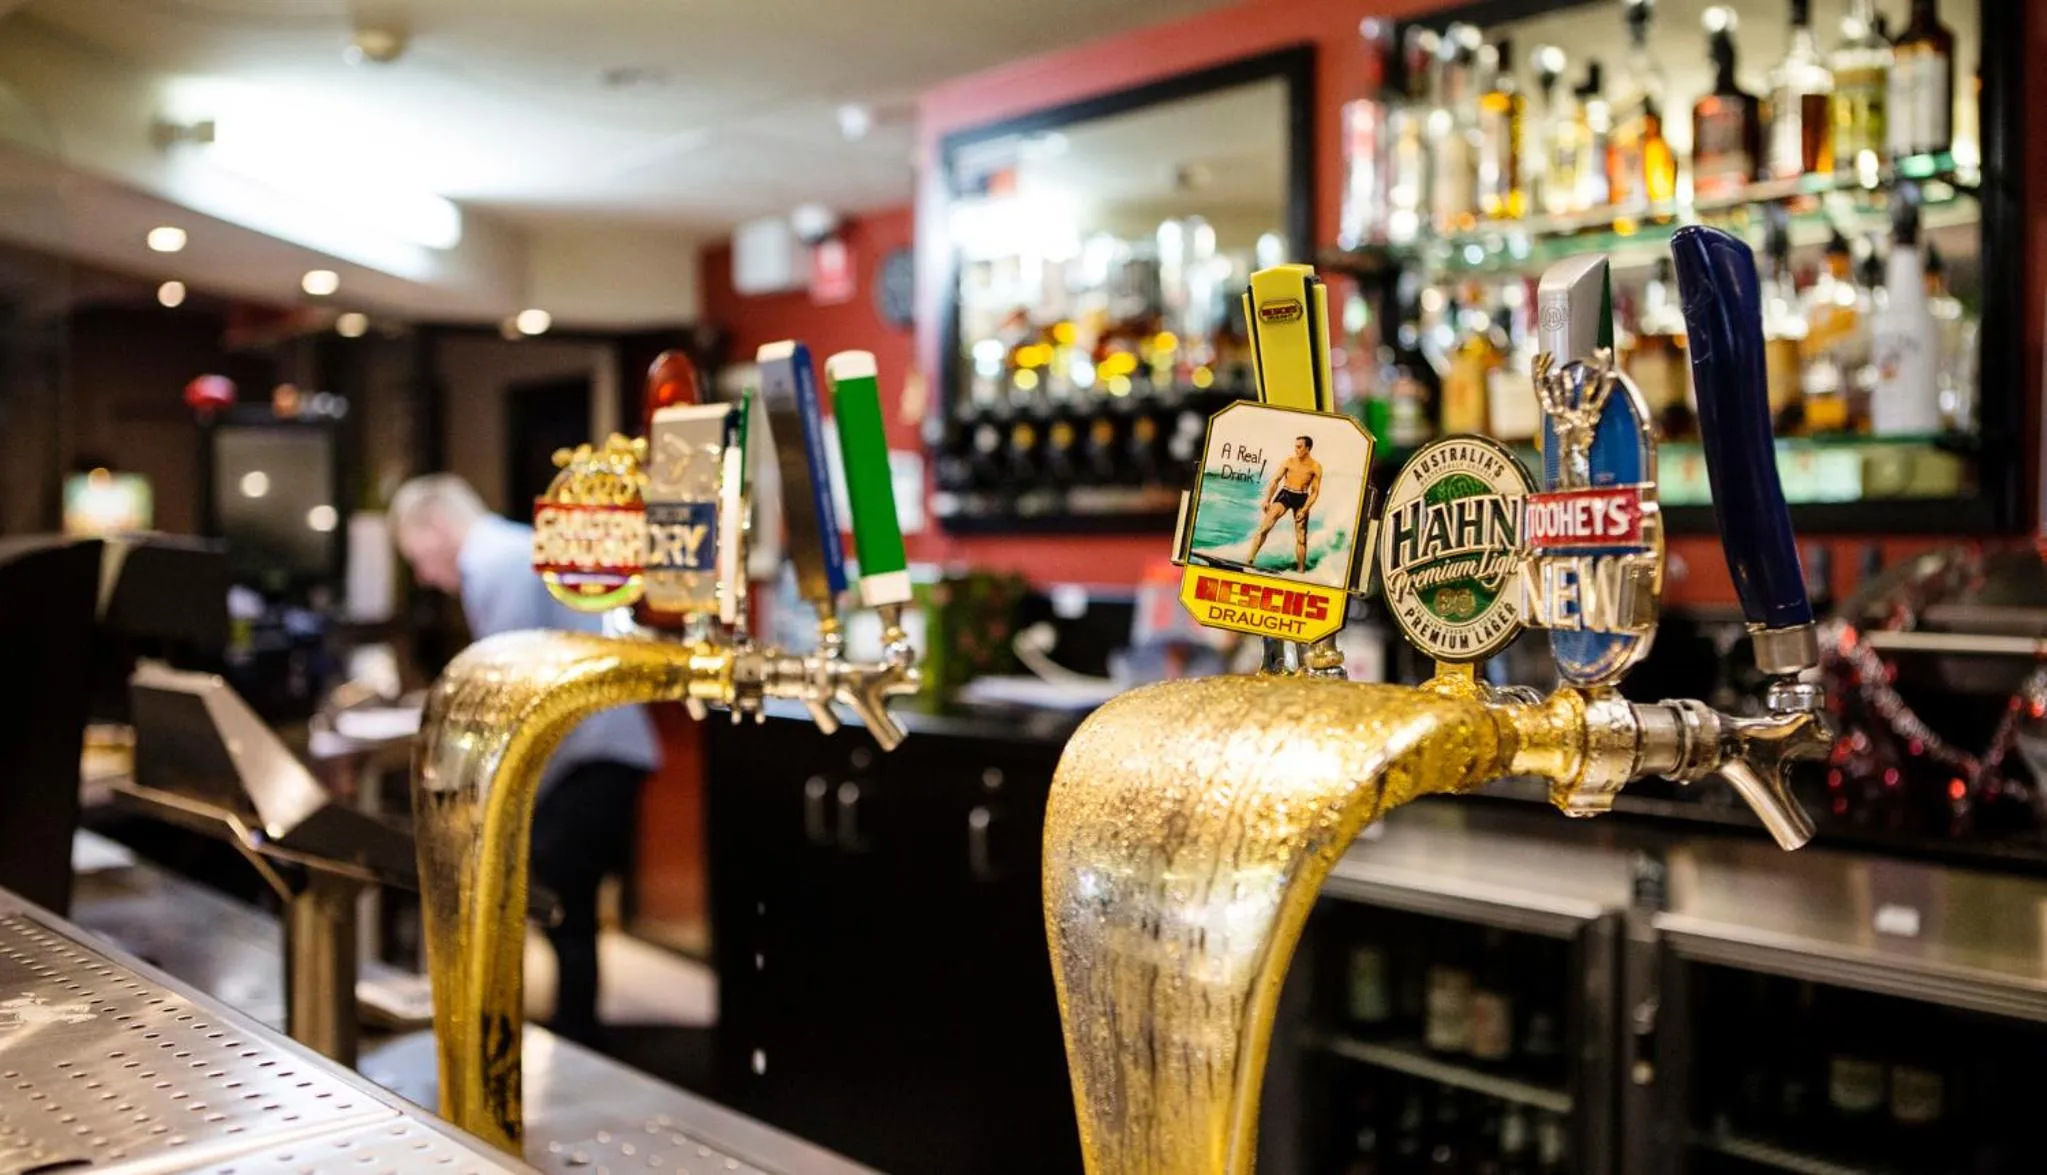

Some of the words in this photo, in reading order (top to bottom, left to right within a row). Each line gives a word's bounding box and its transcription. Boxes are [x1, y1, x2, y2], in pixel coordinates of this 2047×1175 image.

[1220, 442, 1231, 460] A
[1237, 444, 1262, 464] Real
[1220, 459, 1267, 485] Drink!
[1413, 447, 1505, 482] AUSTRALIA'S
[1388, 494, 1524, 573] HAHN
[1527, 497, 1632, 538] TOOHEYS
[1388, 558, 1478, 603] Premium
[1474, 545, 1529, 588] Ligh
[1518, 554, 1643, 634] NEW
[1195, 575, 1329, 621] RESCH'S
[1208, 605, 1306, 634] DRAUGHT
[1404, 607, 1470, 649] PREMIUM
[1474, 602, 1517, 645] LAGER
